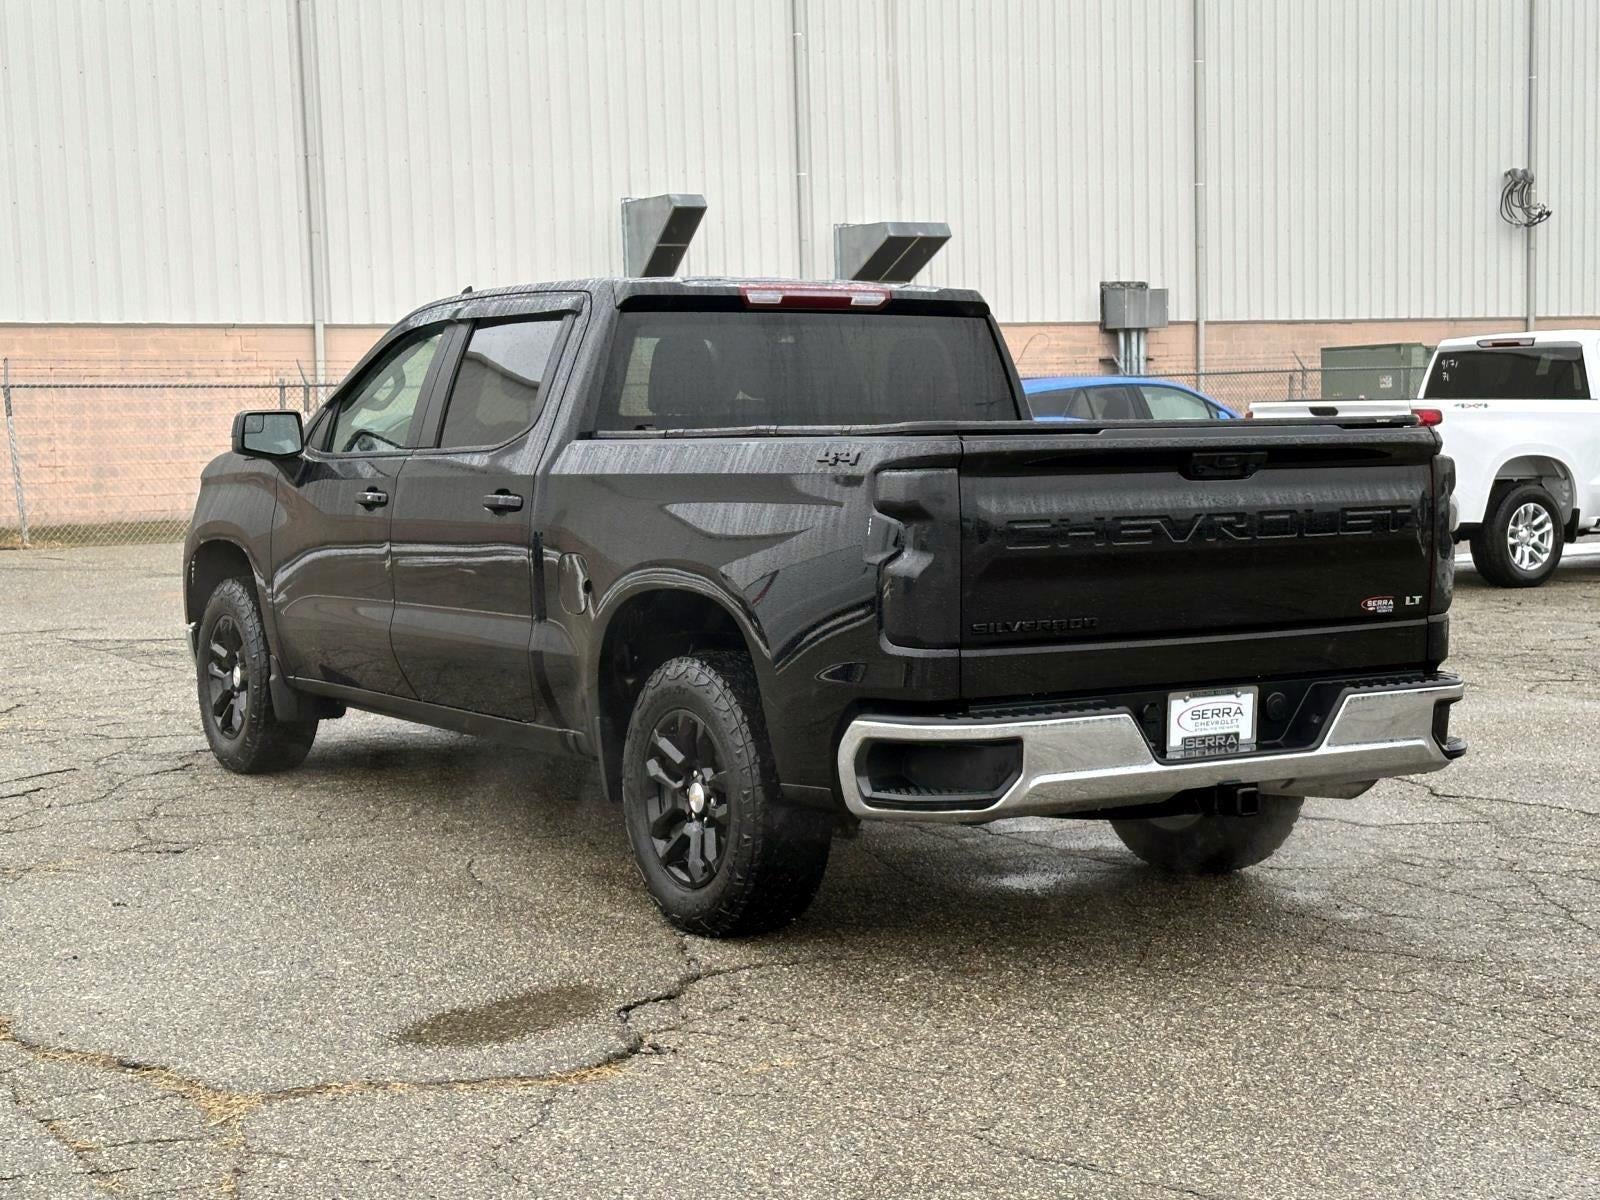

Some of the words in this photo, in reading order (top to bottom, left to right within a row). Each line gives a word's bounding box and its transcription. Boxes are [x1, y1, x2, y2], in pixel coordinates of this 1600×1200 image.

[1006, 505, 1412, 549] CHEVROLET
[1367, 599, 1393, 607] SERRA
[1405, 595, 1423, 606] LT
[970, 614, 1098, 635] SILVERADO
[1191, 706, 1243, 720] SERRA
[1194, 718, 1239, 728] CHEVROLET
[1185, 734, 1238, 749] SERRA
